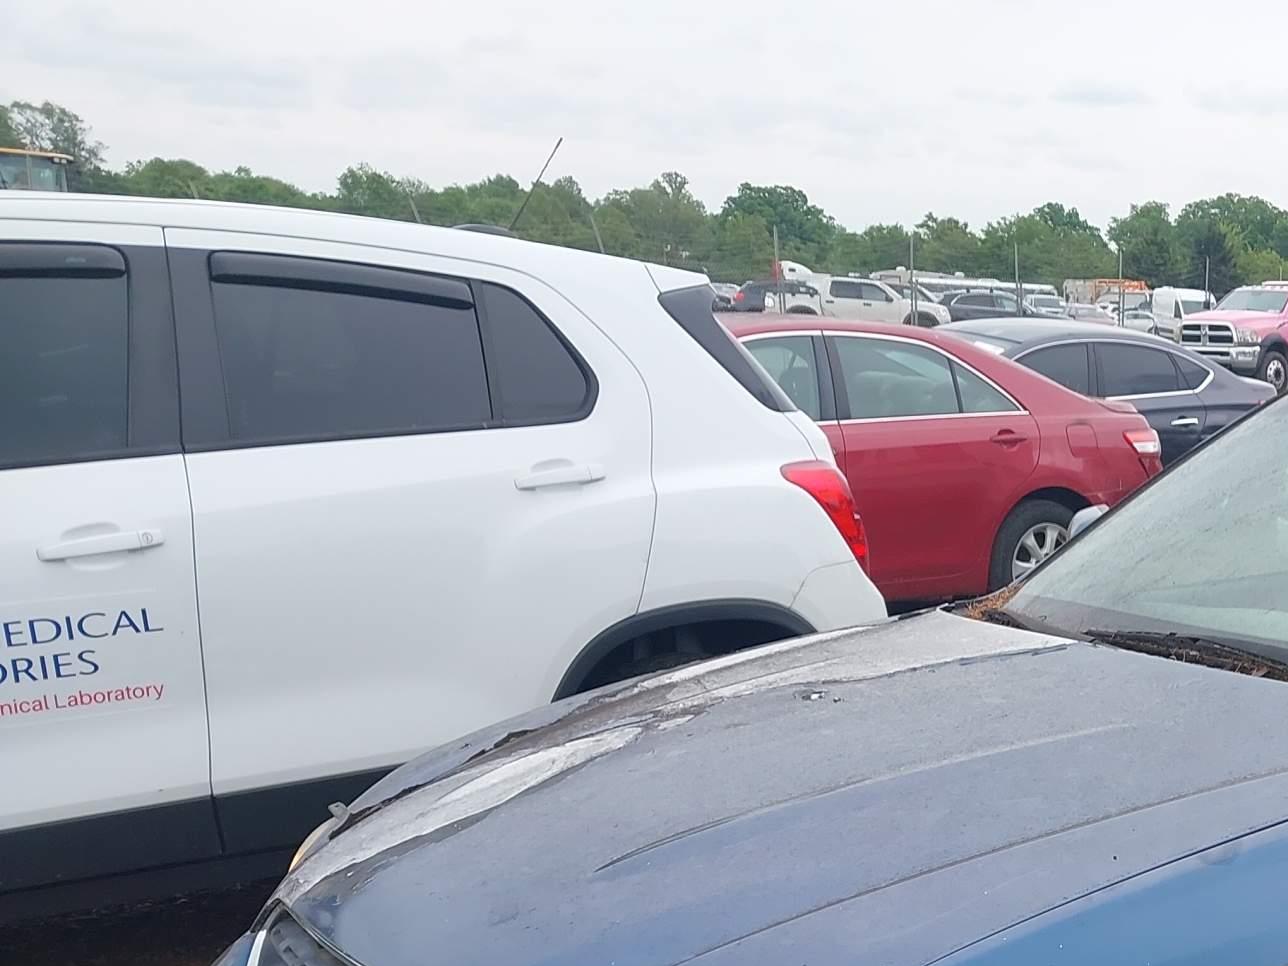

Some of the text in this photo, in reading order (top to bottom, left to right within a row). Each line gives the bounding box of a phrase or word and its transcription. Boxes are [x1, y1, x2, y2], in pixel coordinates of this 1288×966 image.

[3, 608, 164, 648] EDICAL
[0, 650, 100, 685] RIES
[54, 683, 164, 709] Laboratory
